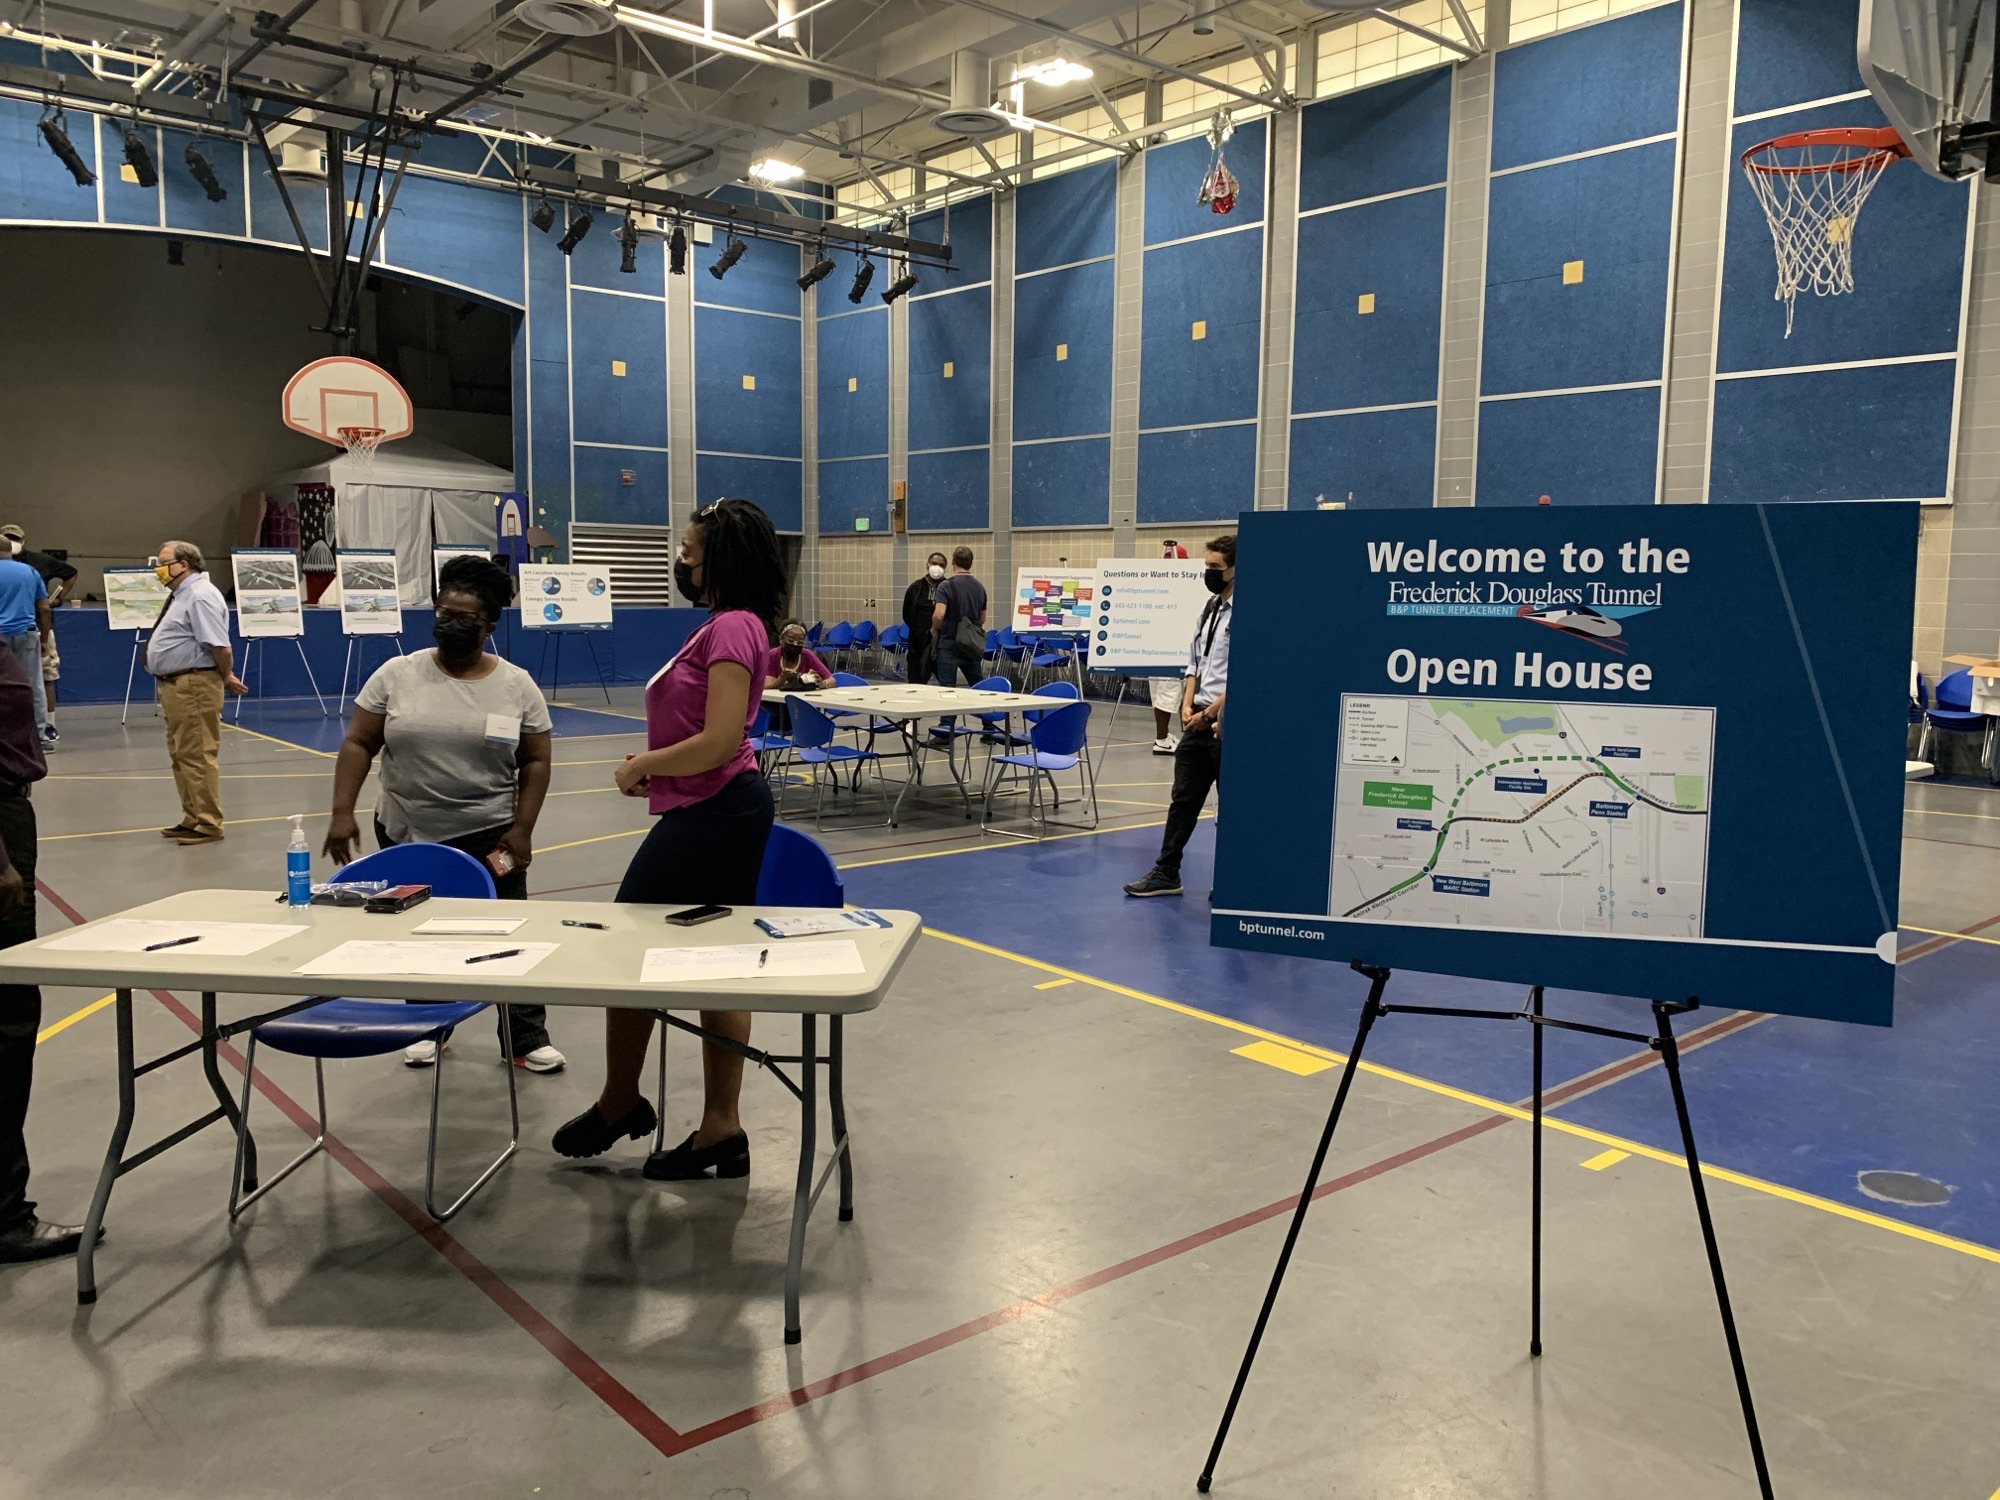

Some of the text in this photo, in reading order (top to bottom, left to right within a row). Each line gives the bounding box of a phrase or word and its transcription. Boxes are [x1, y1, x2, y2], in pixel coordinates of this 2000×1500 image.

[1367, 538, 1690, 574] Welcome to the
[1103, 570, 1139, 579] Questions
[1150, 570, 1169, 578] Want
[1181, 571, 1198, 580] Stay
[1388, 580, 1662, 610] Frederick Douglass Tunnel
[1391, 605, 1514, 616] B&P TUNNEL REPLACEMENT
[1112, 618, 1150, 626] bptunnel.com
[1141, 649, 1178, 657] Replacement
[1386, 649, 1652, 693] Open House
[1368, 791, 1428, 801] Frederick Douglass
[1386, 798, 1409, 806] Tunnel
[1669, 801, 1697, 810] Corridor
[1595, 803, 1623, 811] Baltimore
[1590, 809, 1603, 817] Penn
[1443, 884, 1460, 892] MARC
[1462, 879, 1488, 888] Baltimore
[1397, 882, 1420, 898] Corridor
[1239, 920, 1325, 940] bptunnel.com
